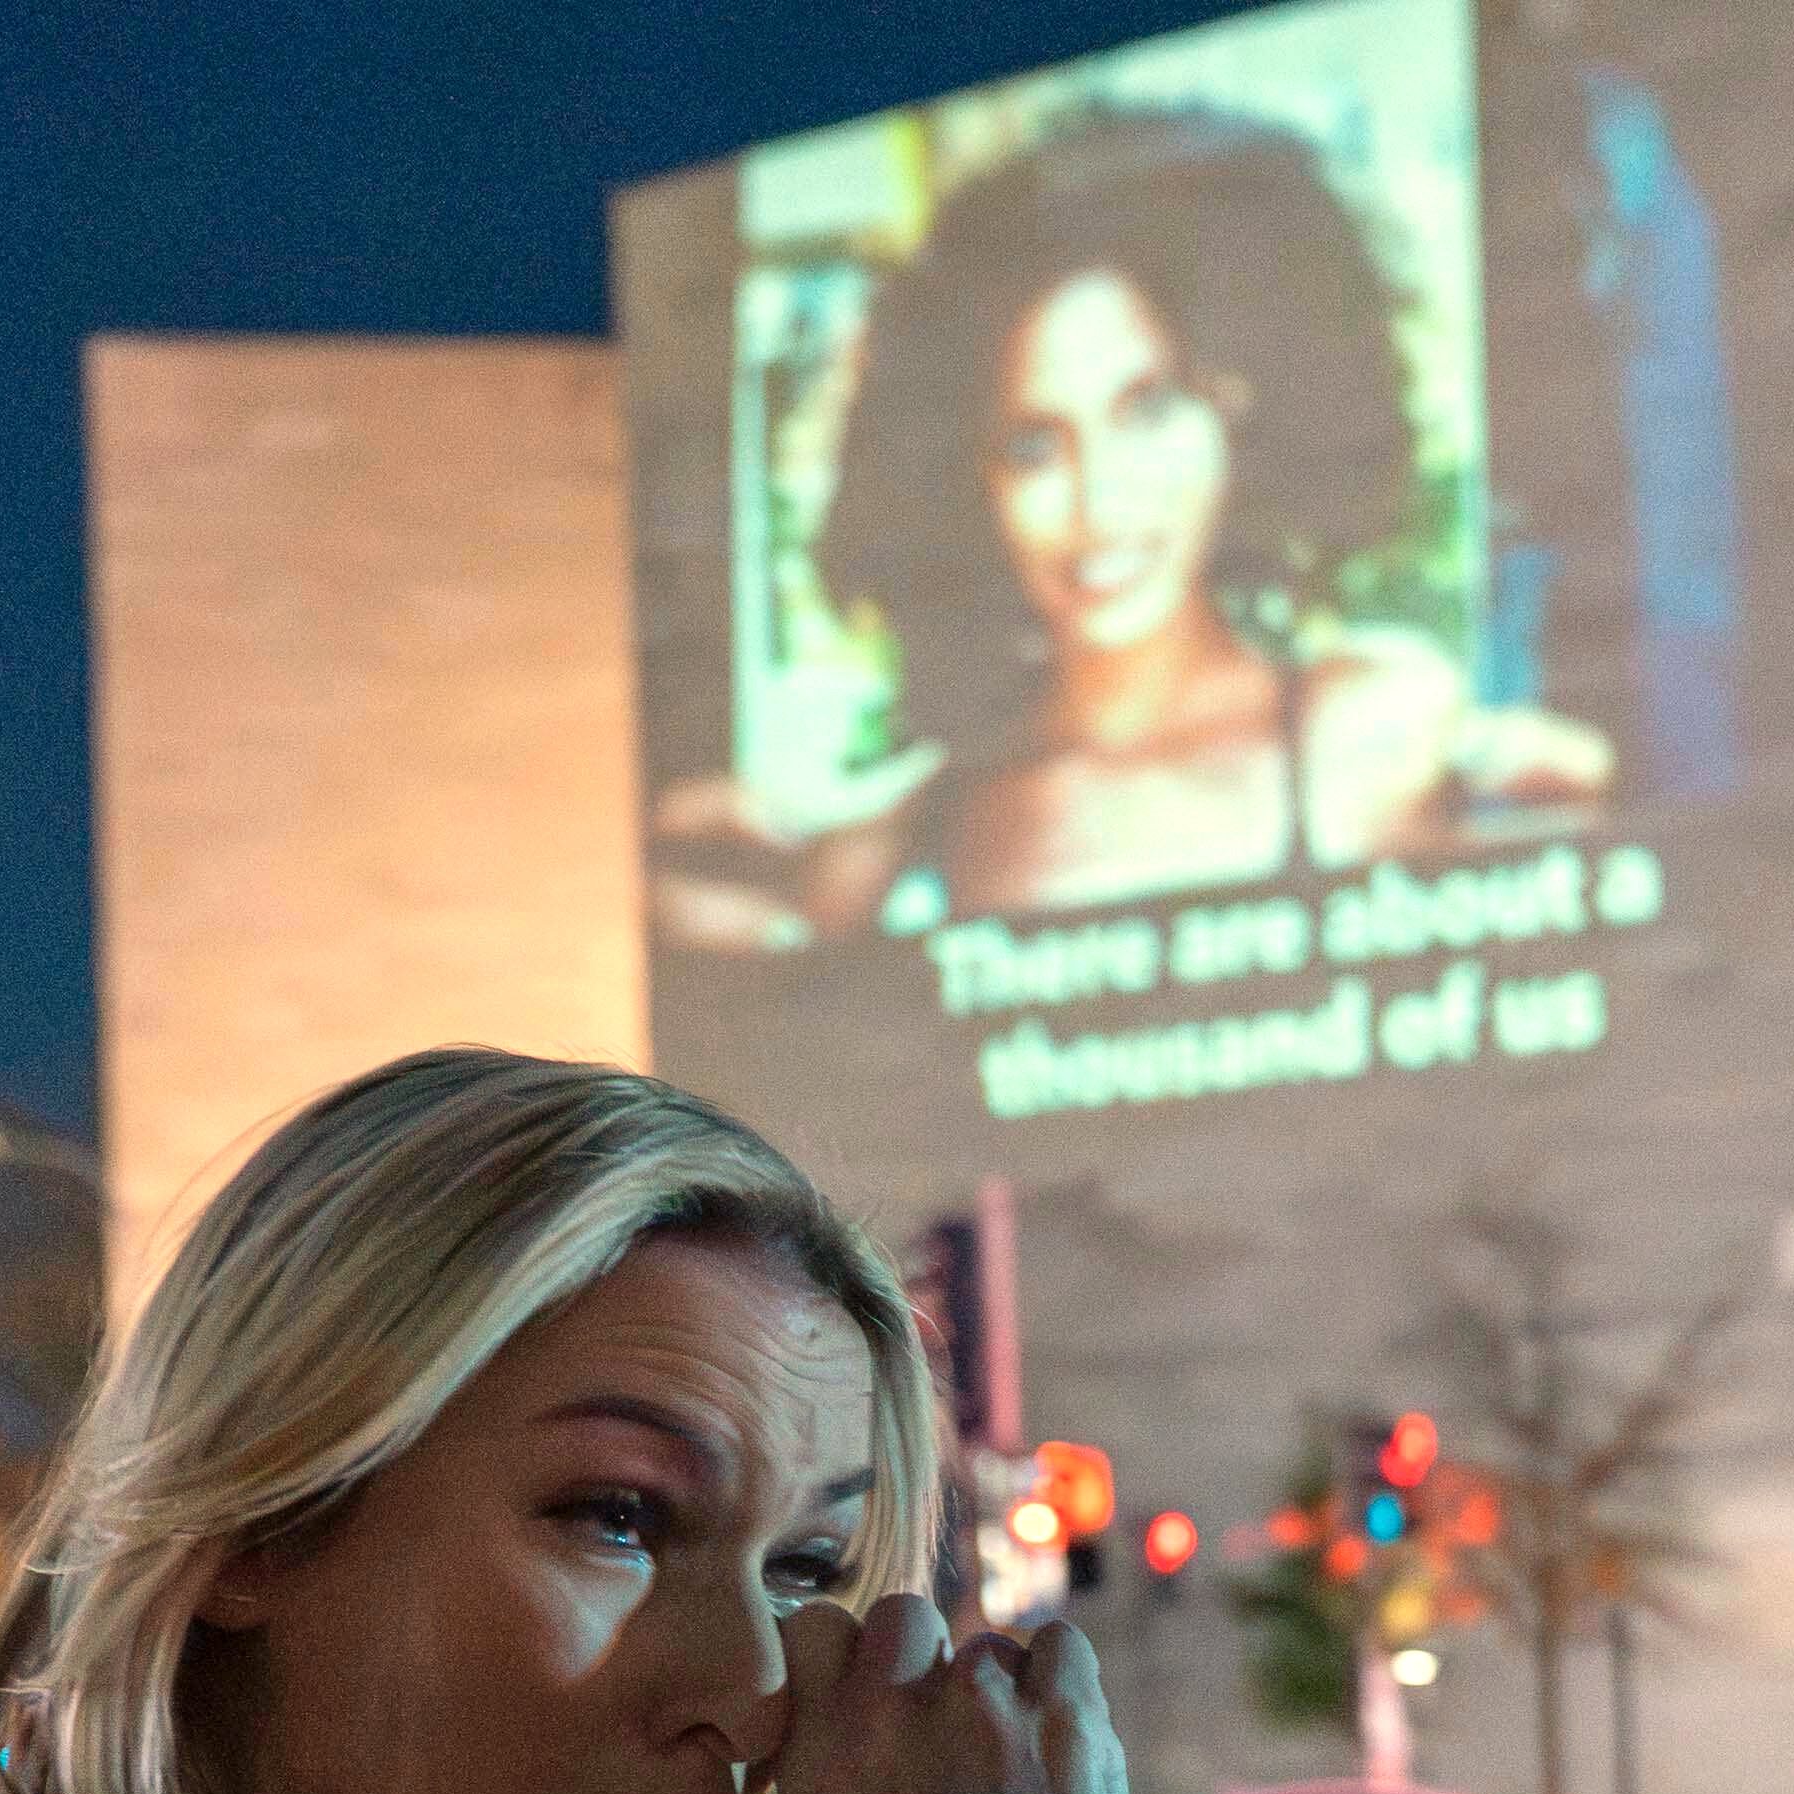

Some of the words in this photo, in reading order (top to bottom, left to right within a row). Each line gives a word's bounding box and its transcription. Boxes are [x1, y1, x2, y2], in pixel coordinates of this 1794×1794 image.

[1170, 896, 1310, 984] are
[1320, 845, 1587, 963] about
[1596, 844, 1664, 926] a
[979, 972, 1370, 1119] thousand
[1380, 957, 1486, 1070] of
[1493, 968, 1606, 1056] us
